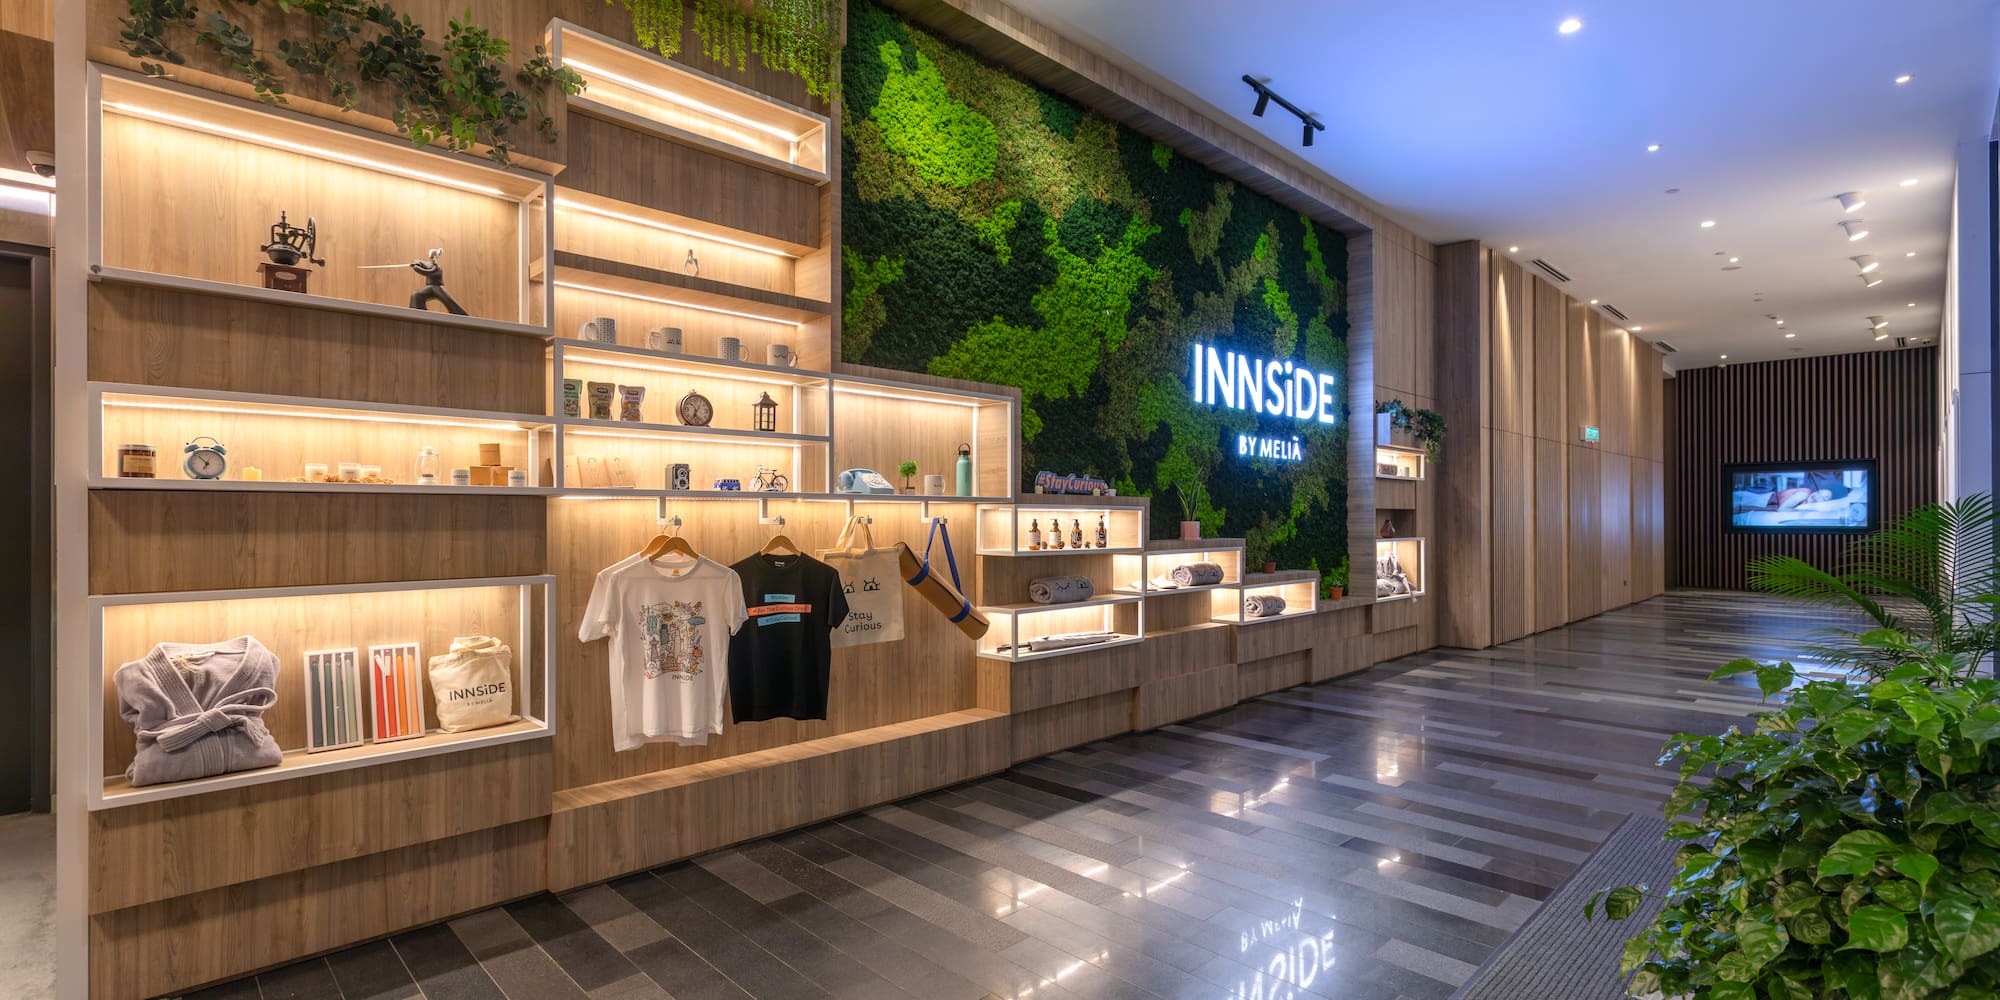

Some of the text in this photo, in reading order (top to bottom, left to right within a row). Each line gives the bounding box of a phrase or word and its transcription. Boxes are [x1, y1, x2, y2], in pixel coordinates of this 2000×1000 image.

[1195, 343, 1335, 424] INNSiDE
[1239, 434, 1257, 456] BY
[844, 611, 882, 634] Stay Curious
[449, 682, 506, 701] INNSiDE
